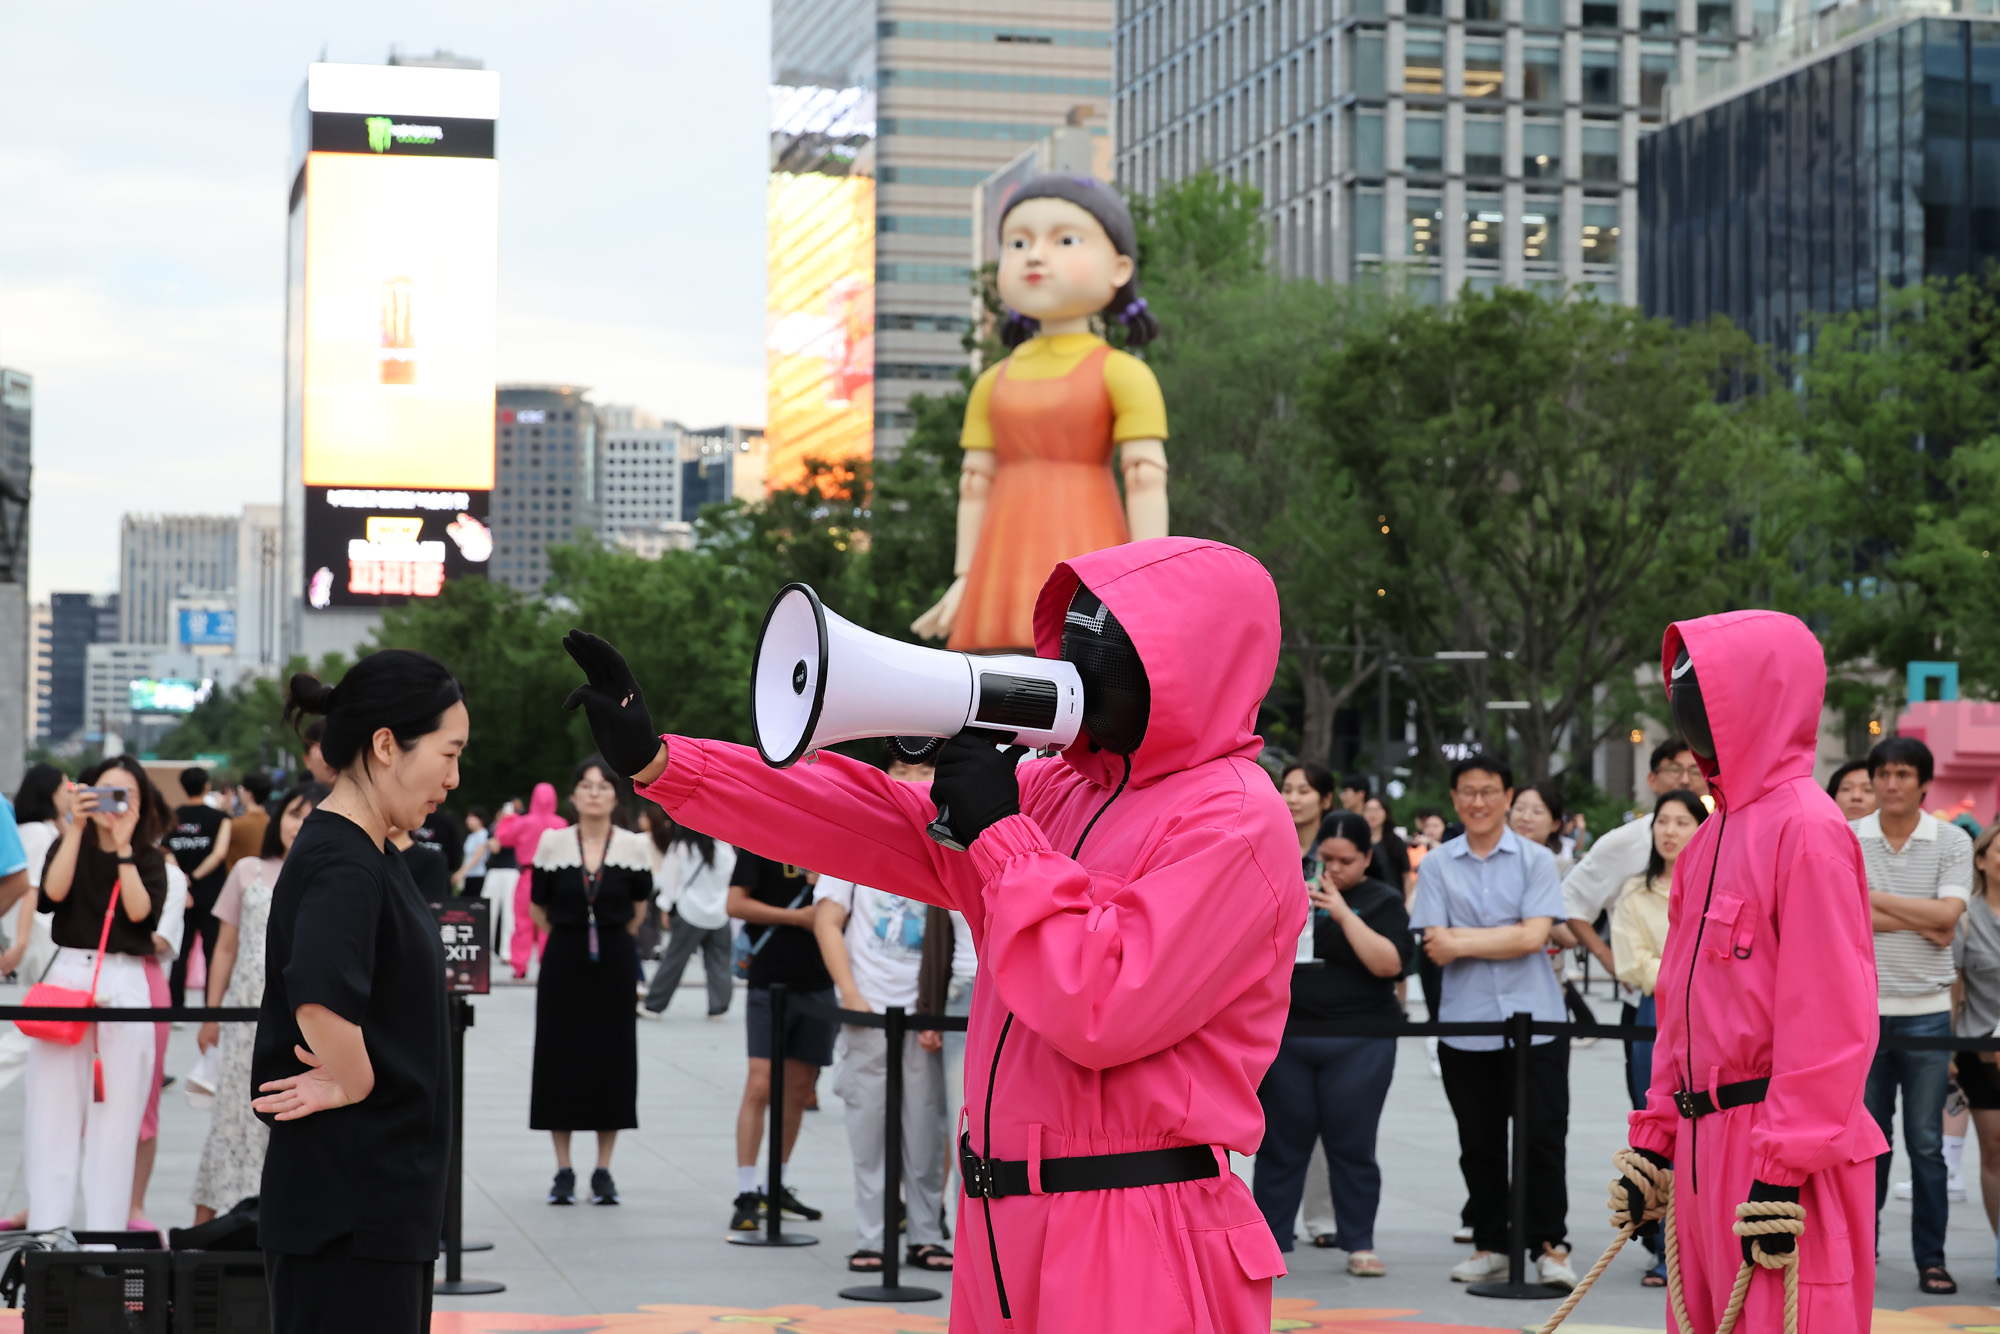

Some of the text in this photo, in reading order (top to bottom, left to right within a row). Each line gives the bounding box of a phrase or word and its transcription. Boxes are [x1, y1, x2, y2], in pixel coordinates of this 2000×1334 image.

[169, 836, 211, 850] STAFF
[440, 924, 474, 943] 출구
[444, 944, 481, 961] XIT
